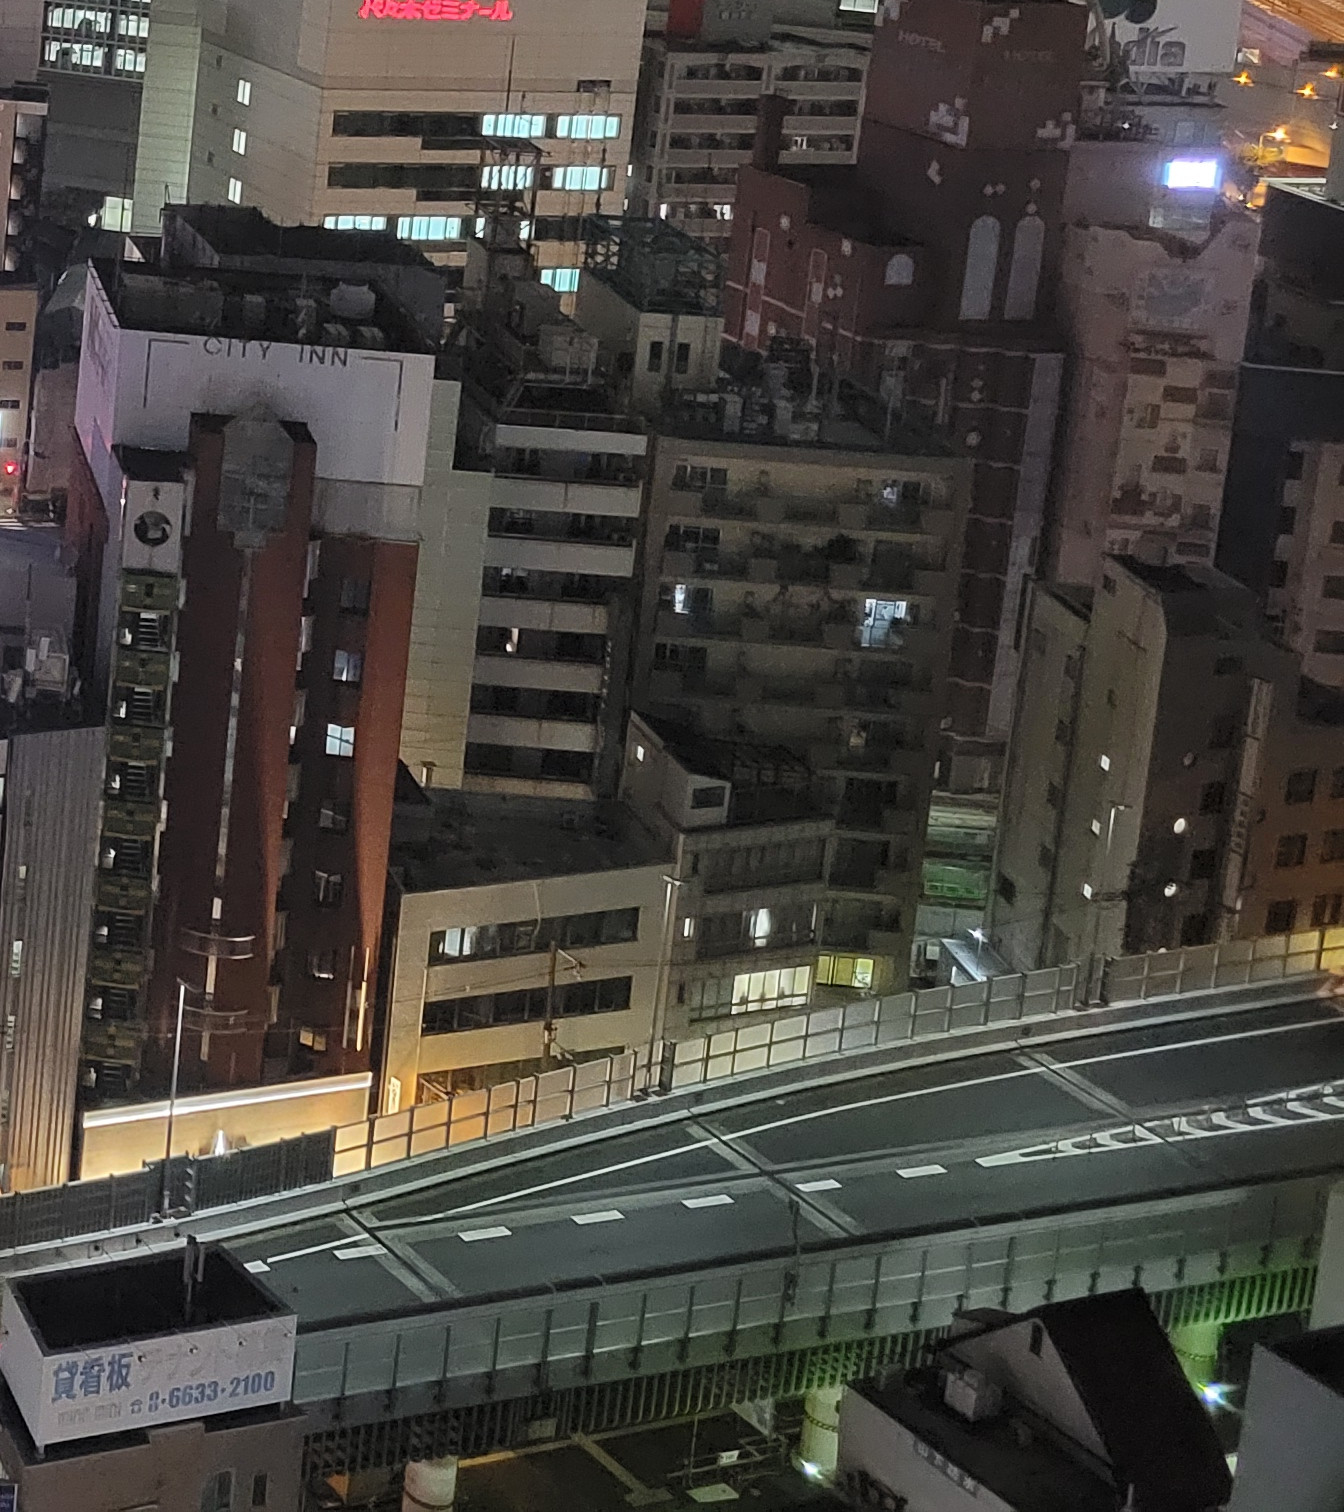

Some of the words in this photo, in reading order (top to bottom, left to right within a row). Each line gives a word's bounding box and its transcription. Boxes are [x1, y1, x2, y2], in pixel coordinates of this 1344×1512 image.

[203, 337, 272, 360] CITY
[298, 344, 349, 367] INN
[52, 1352, 133, 1403] 貸看板
